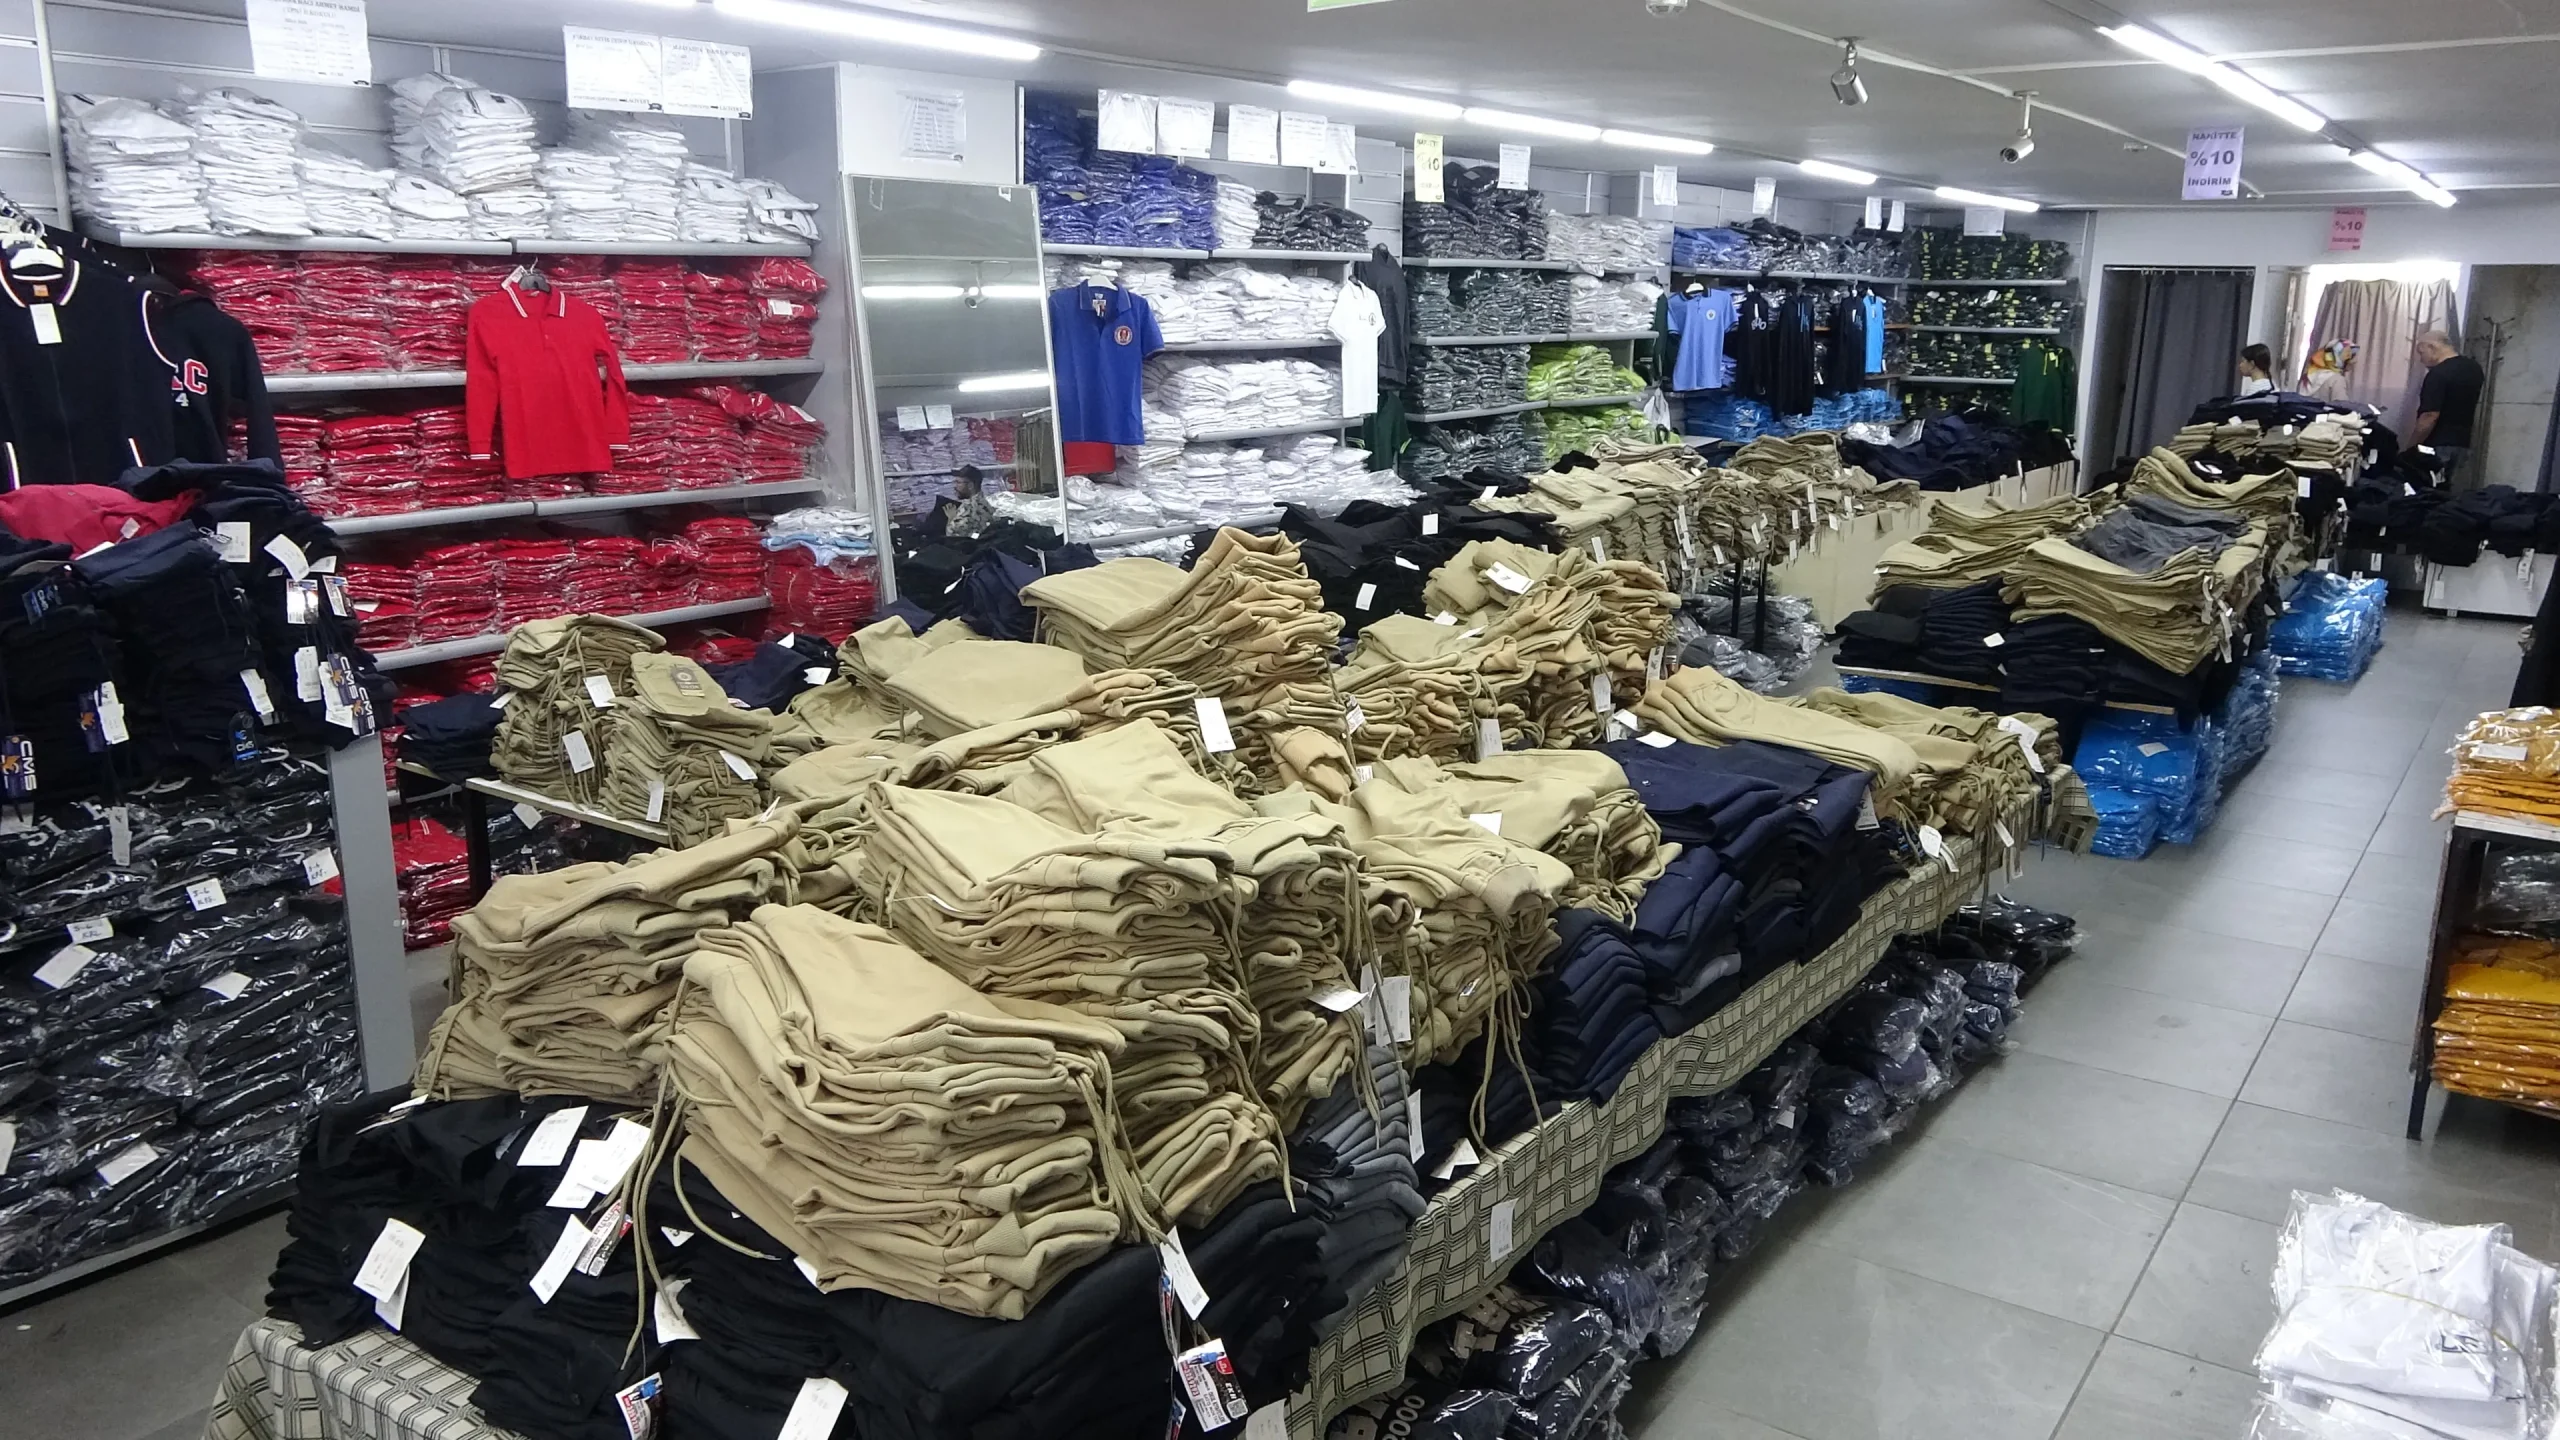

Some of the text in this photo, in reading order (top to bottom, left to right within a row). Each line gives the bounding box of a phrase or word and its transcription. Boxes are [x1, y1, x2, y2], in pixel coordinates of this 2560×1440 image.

[2192, 131, 2238, 140] NAKİTTE
[2190, 150, 2235, 167] %10
[2187, 176, 2232, 187] İNDİRİM
[2334, 220, 2363, 231] %10
[340, 656, 359, 700] CMS
[359, 687, 376, 730] CMS
[20, 740, 37, 791] CMS
